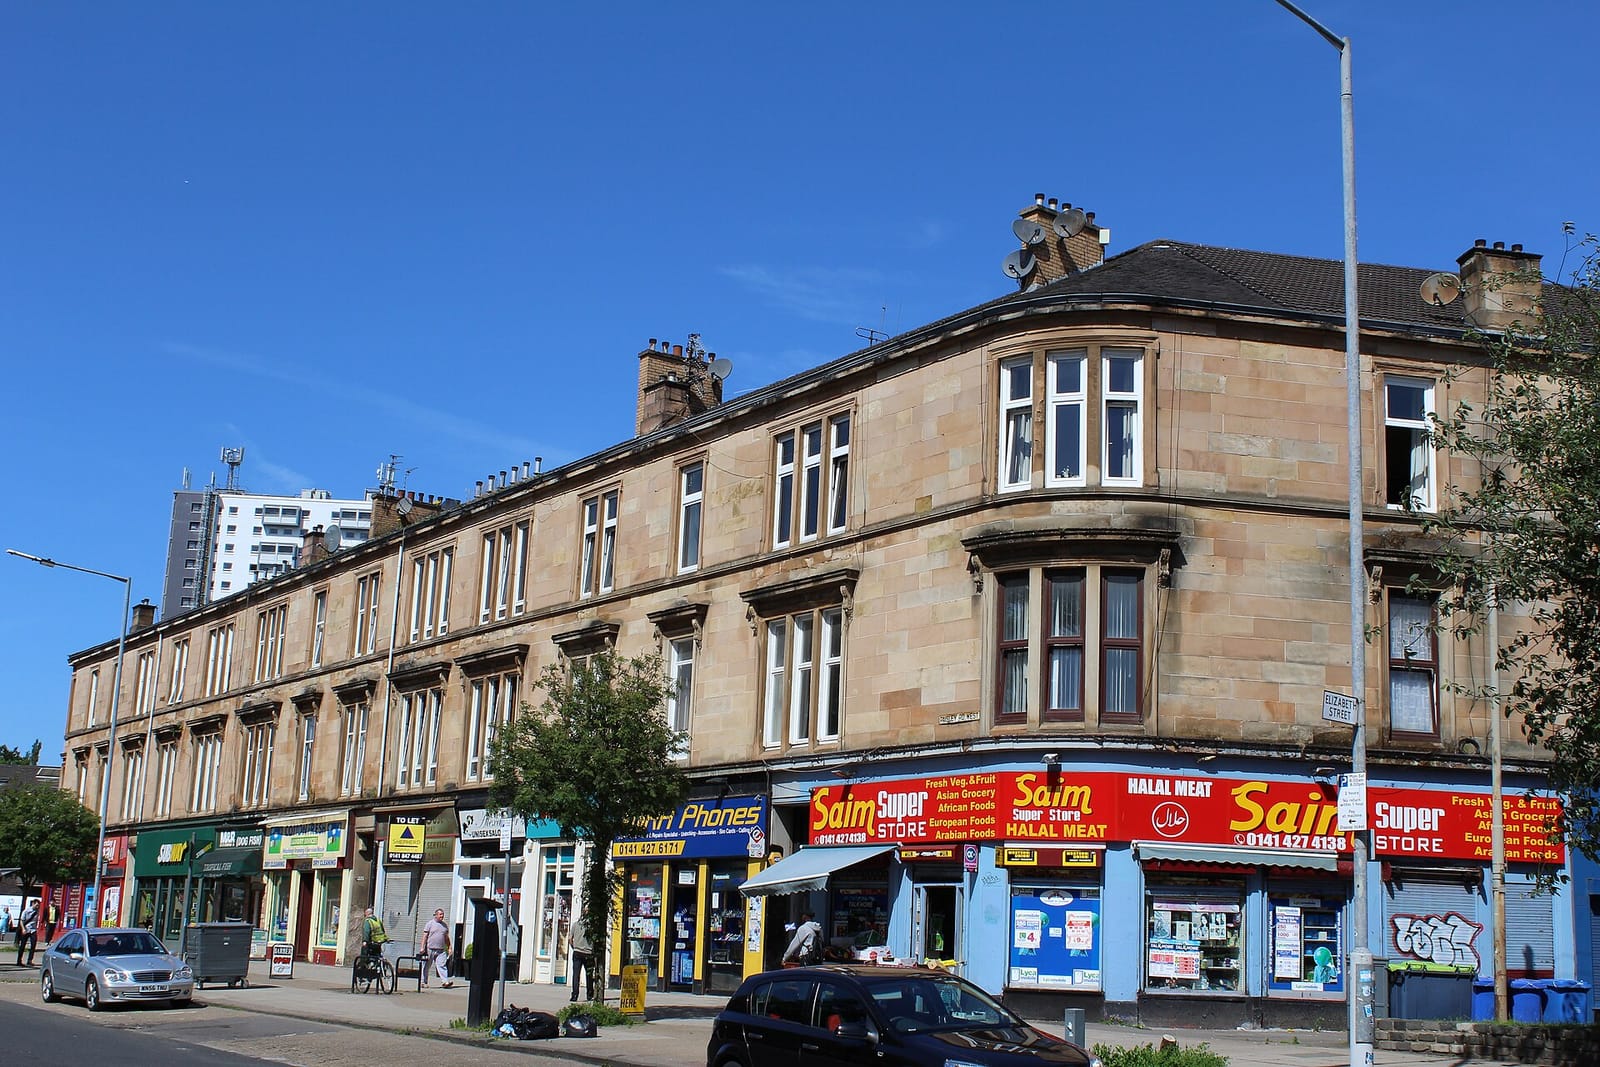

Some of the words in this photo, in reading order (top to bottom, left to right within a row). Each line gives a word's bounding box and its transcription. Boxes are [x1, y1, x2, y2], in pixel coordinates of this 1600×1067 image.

[1329, 707, 1351, 720] STREET
[925, 779, 948, 789] Fresh
[1128, 778, 1171, 795] HALAL
[1175, 780, 1213, 797] MEAT
[936, 791, 960, 800] Asian
[962, 788, 996, 799] Grocery
[1013, 773, 1093, 815] Saim
[877, 791, 928, 821] Super
[937, 802, 968, 812] African
[970, 801, 996, 810] Foods
[1452, 796, 1485, 807] Fresh
[1518, 799, 1527, 808] &
[1530, 800, 1558, 810] Fruit
[679, 804, 762, 829] Phones
[813, 788, 876, 836] Saim
[1013, 808, 1043, 821] Super
[1049, 808, 1081, 821] Store
[1155, 807, 1186, 828] حلال
[1375, 802, 1445, 833] Super
[1474, 809, 1507, 819] Asin
[929, 818, 968, 828] European
[970, 816, 996, 825] Foods
[489, 829, 502, 837] SALO
[878, 821, 927, 838] STORE
[936, 831, 968, 840] Arabian
[970, 829, 996, 838] Foods
[1006, 823, 1058, 838] HALAL
[1064, 824, 1107, 838] MEAT
[427, 841, 448, 849] SERVICE
[819, 834, 835, 845] 0141
[1247, 833, 1279, 847] 0141
[1282, 835, 1309, 848] 427
[1312, 836, 1346, 850] 4138
[1376, 836, 1443, 852] STORE
[158, 841, 187, 863] SUBWAY
[619, 844, 637, 855] 0141
[641, 843, 656, 853] 427
[659, 842, 679, 853] 6171
[274, 957, 291, 965] OPEN
[1020, 969, 1036, 977] Lyca
[621, 998, 637, 1008] HERE
